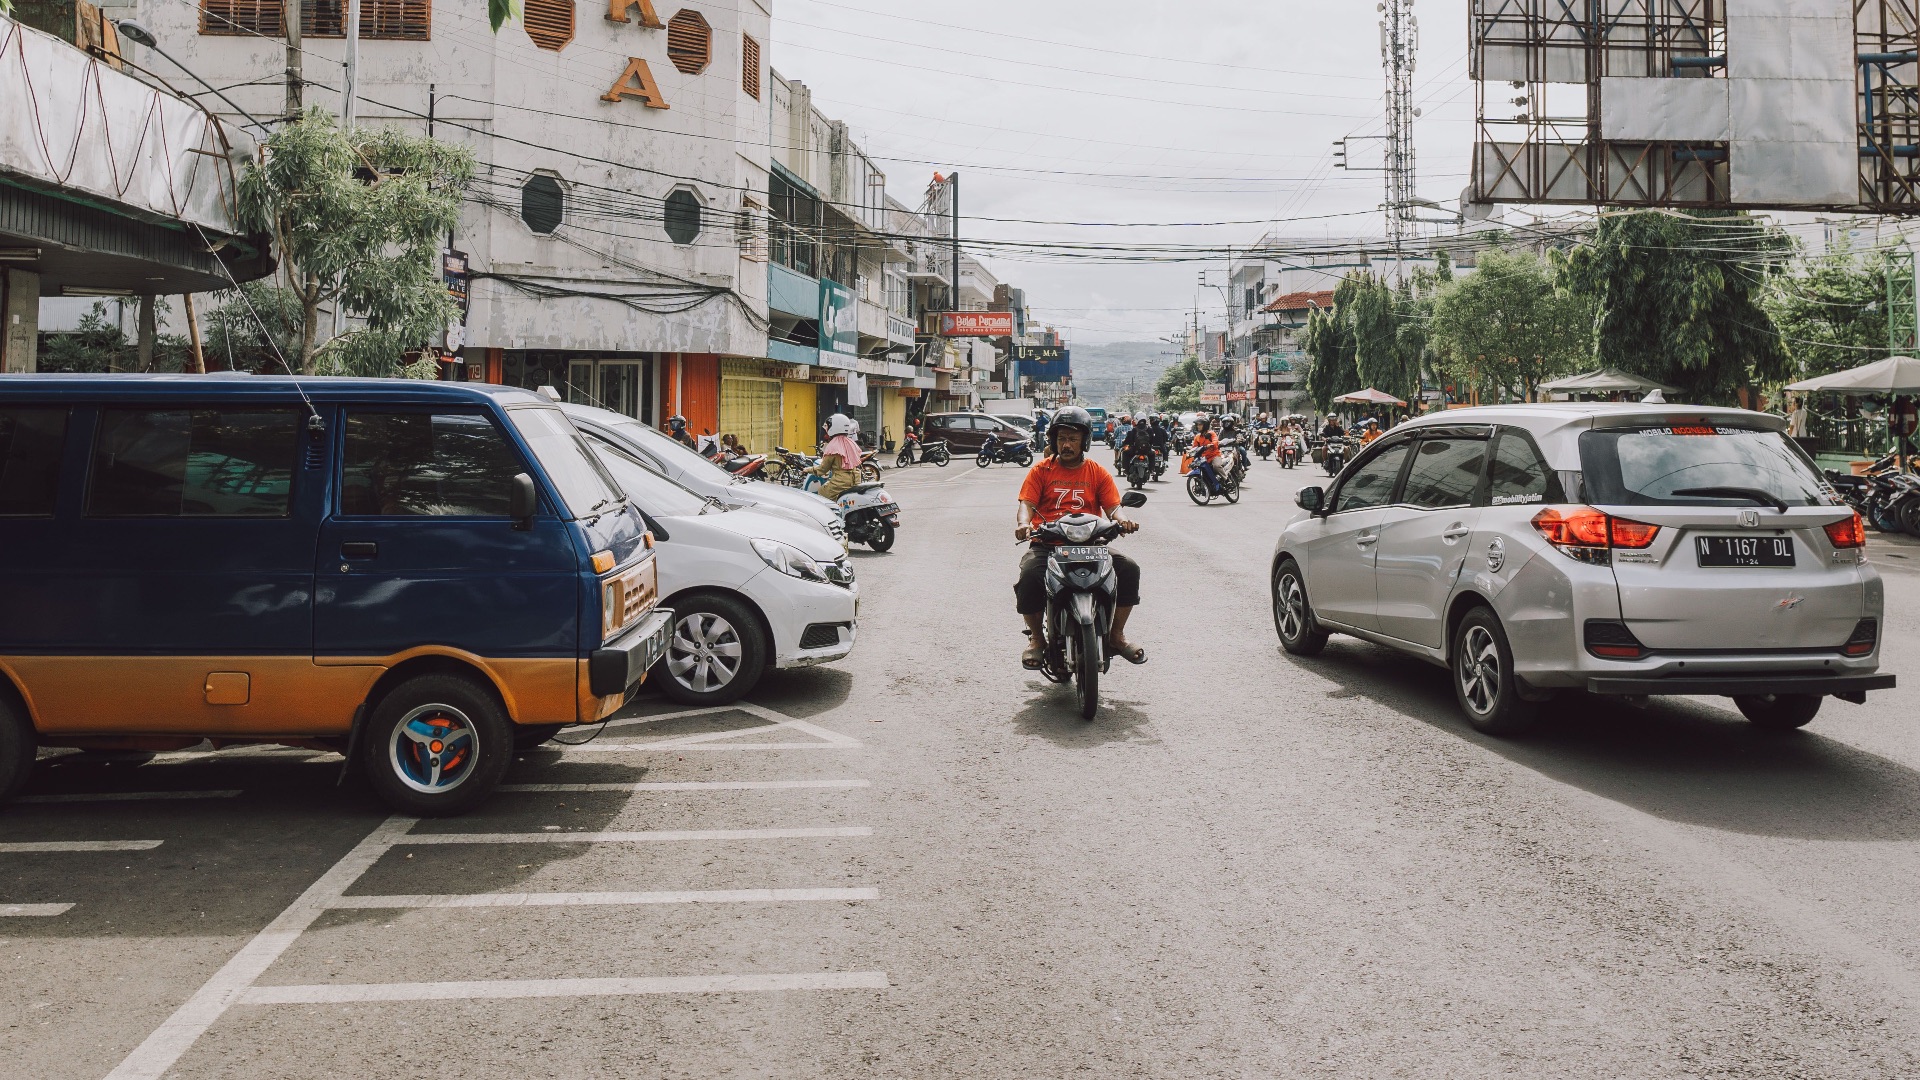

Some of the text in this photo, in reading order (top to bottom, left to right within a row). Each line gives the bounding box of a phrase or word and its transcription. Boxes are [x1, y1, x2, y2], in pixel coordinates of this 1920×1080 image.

[1054, 488, 1085, 510] 75
[1071, 547, 1090, 555] 4167
[1700, 538, 1791, 556] N 1167 DL
